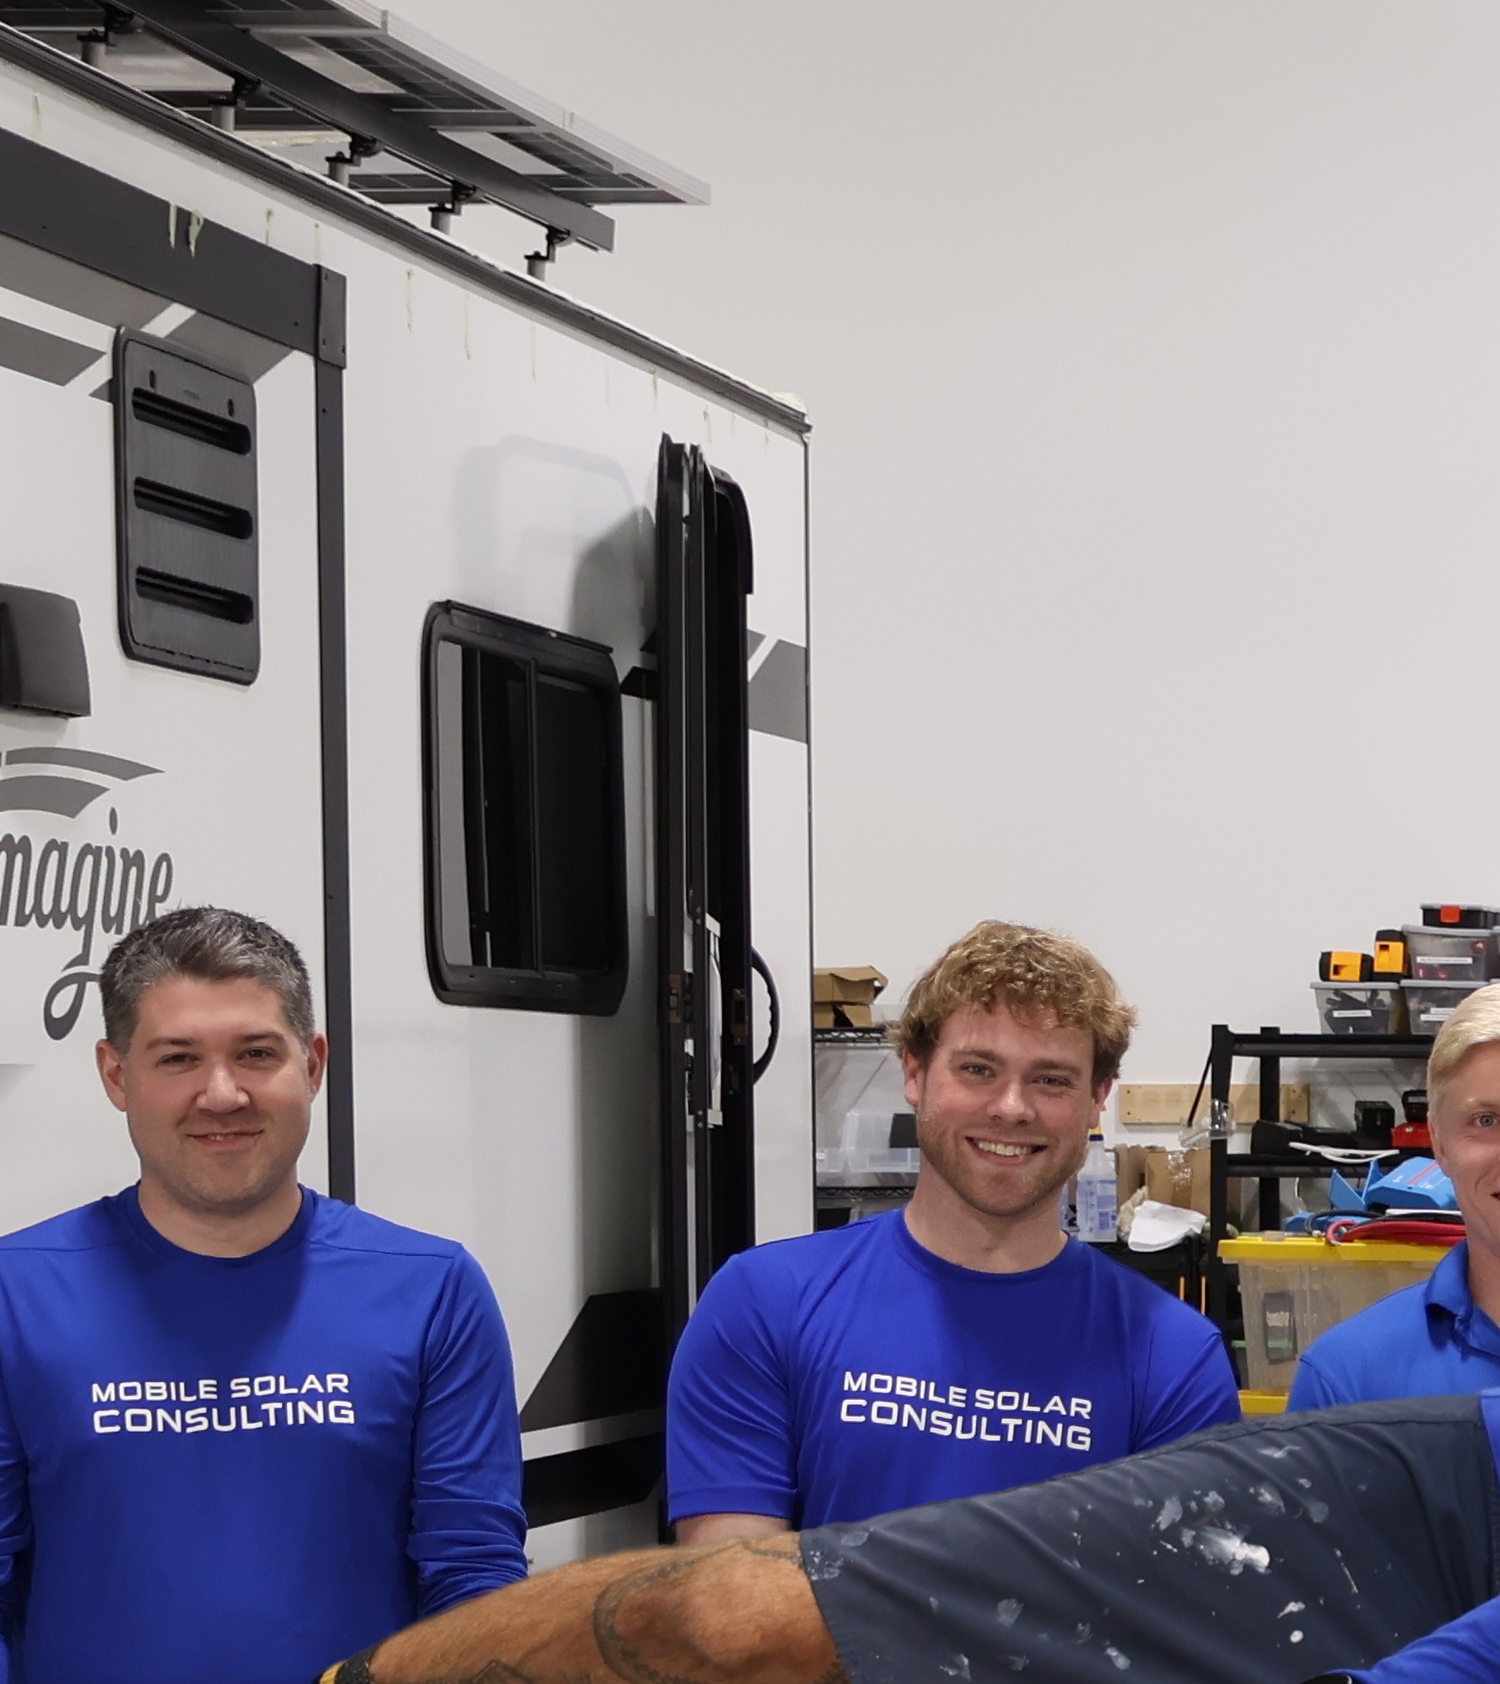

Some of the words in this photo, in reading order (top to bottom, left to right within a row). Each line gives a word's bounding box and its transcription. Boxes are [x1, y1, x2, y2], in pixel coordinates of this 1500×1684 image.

[92, 1379, 218, 1402] MOBILE
[230, 1373, 350, 1398] SOLAR
[843, 1371, 968, 1407] MOBILE
[974, 1388, 1092, 1419] SOLAR
[93, 1400, 355, 1433] CONSULTING
[840, 1399, 1092, 1451] CONSULTING
